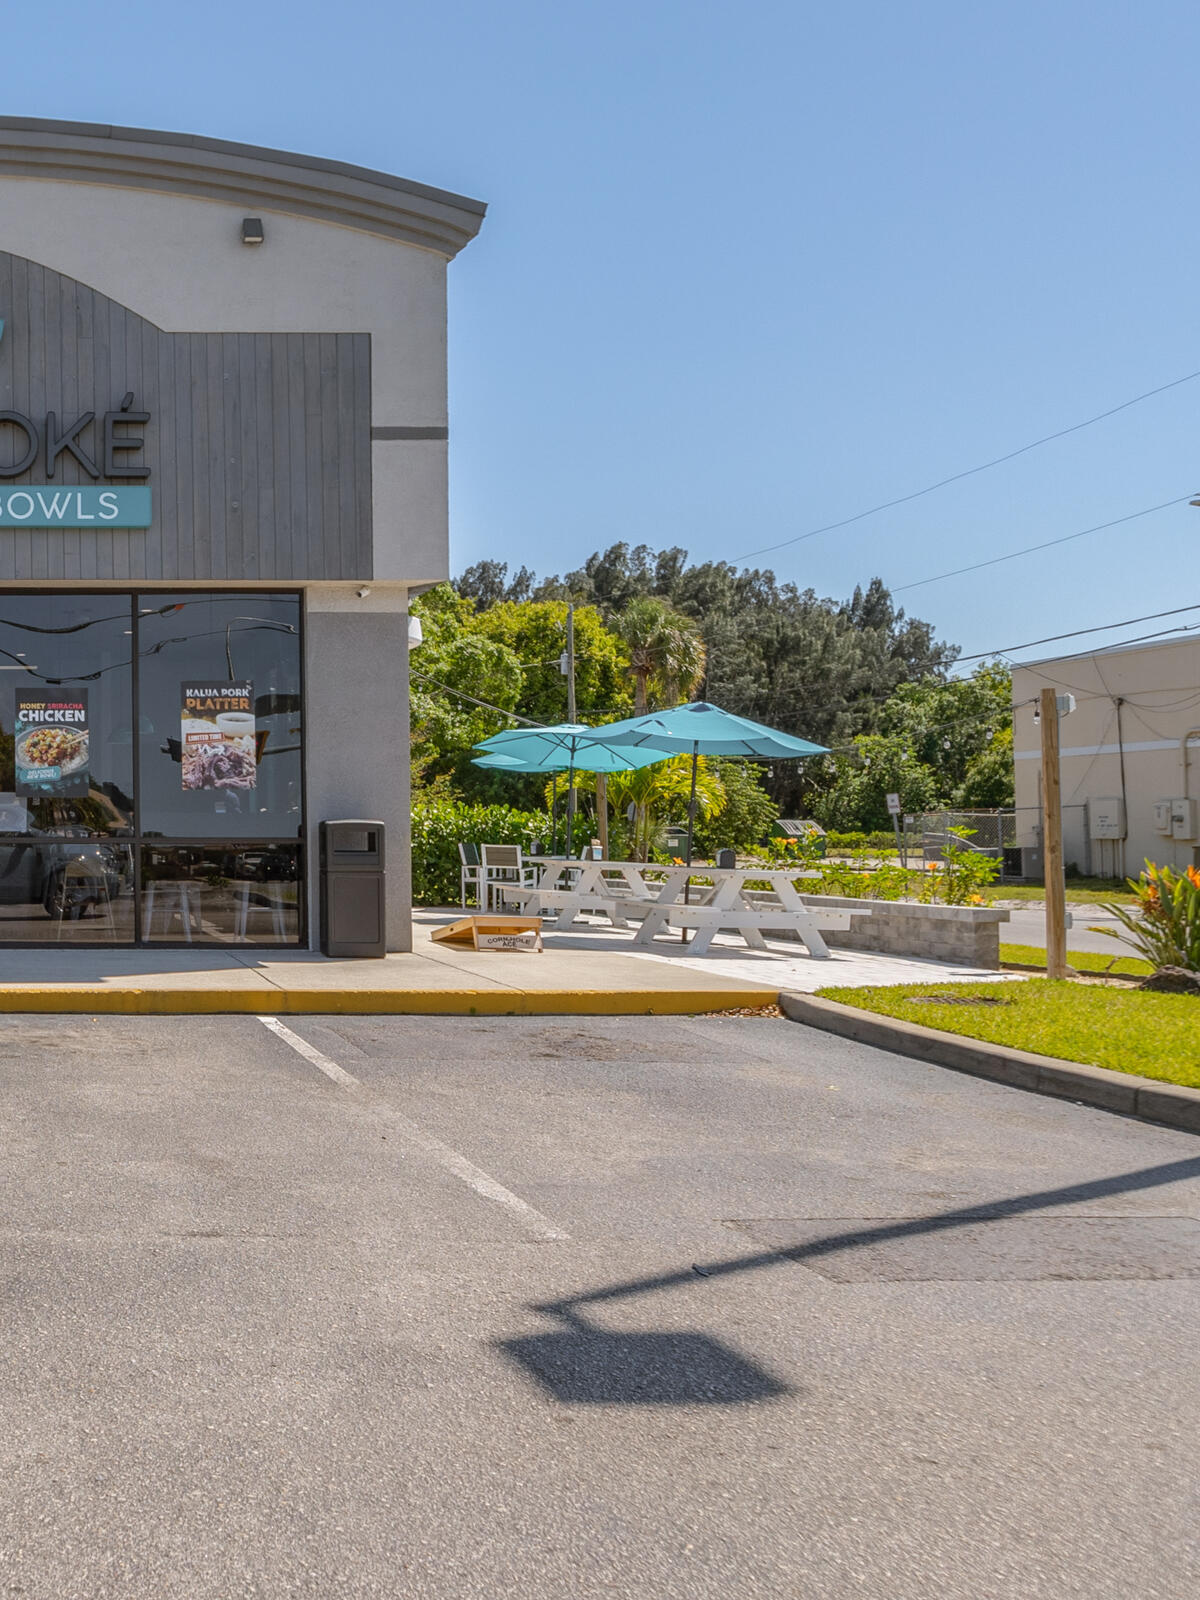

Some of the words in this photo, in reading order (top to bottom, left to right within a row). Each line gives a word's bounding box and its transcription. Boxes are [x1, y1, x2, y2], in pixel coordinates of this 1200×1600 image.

[221, 688, 250, 697] PORK
[186, 698, 250, 710] PLATTER
[18, 710, 86, 722] CHICKEN
